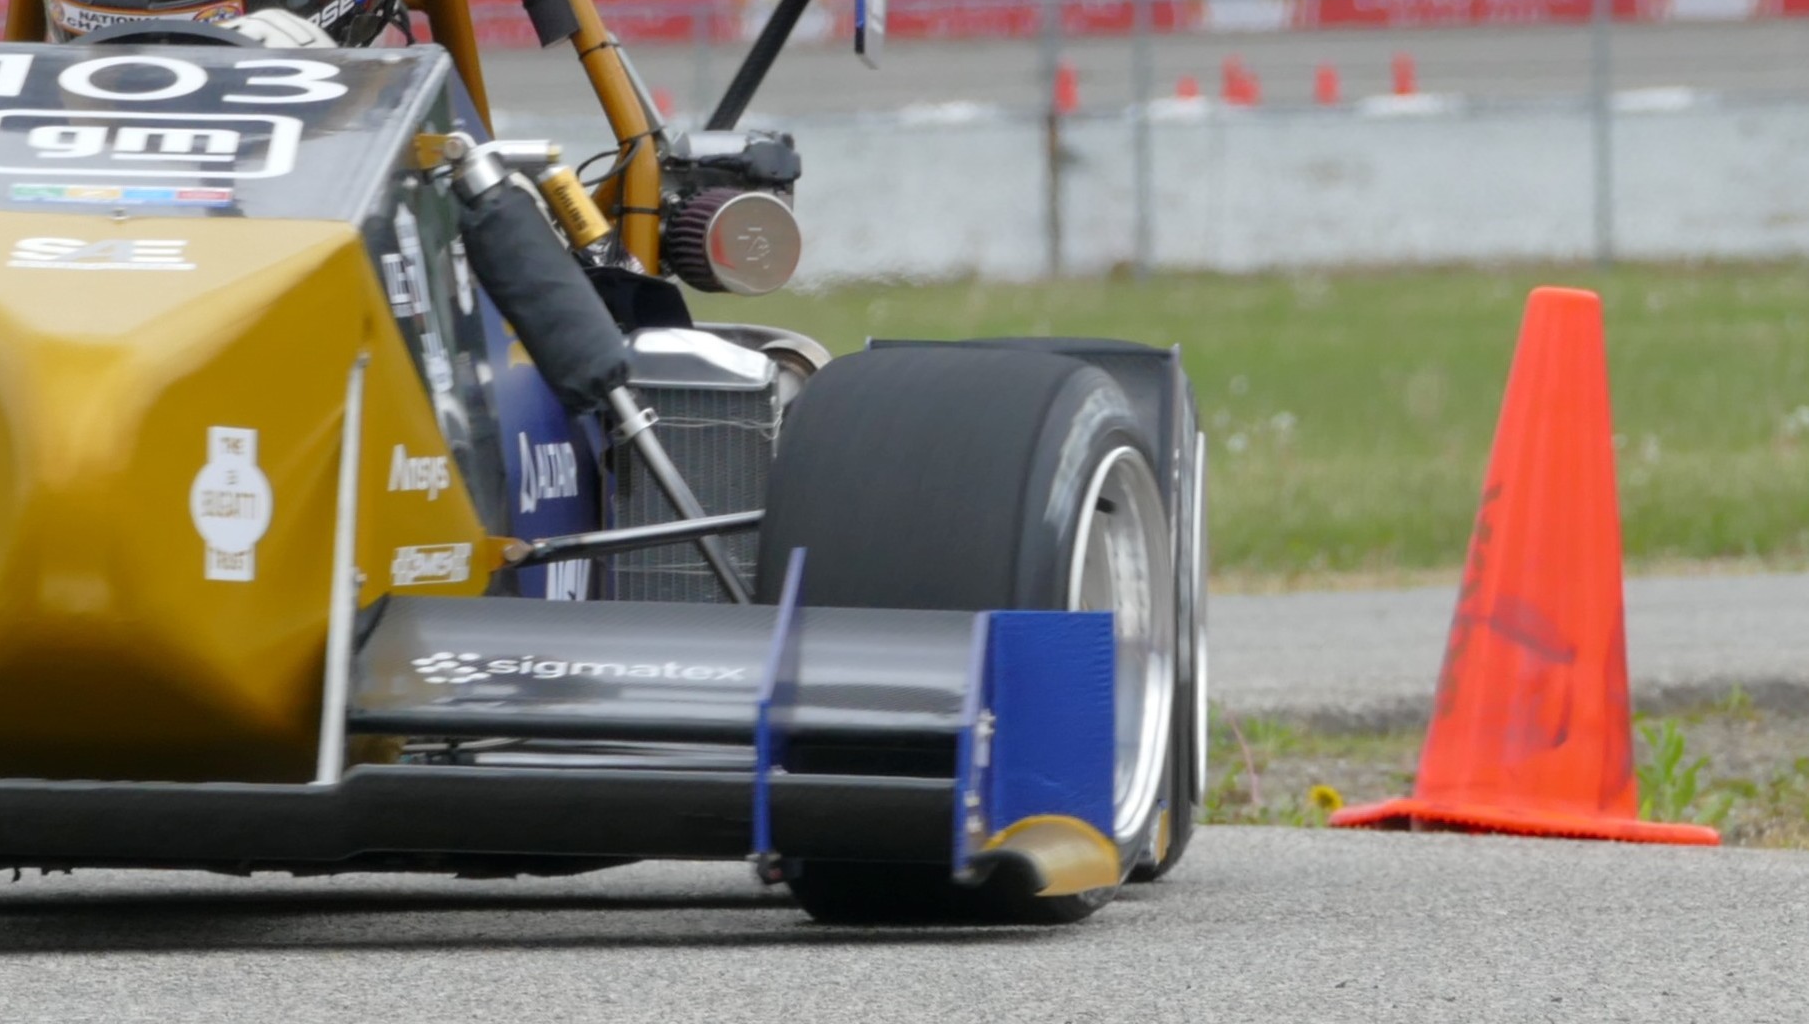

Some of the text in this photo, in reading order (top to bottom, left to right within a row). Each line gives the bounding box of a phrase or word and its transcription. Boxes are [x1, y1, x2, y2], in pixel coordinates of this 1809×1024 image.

[78, 10, 160, 25] NATIO
[27, 124, 241, 162] gm
[9, 237, 189, 263] SAE
[487, 655, 746, 681] sigmatex
